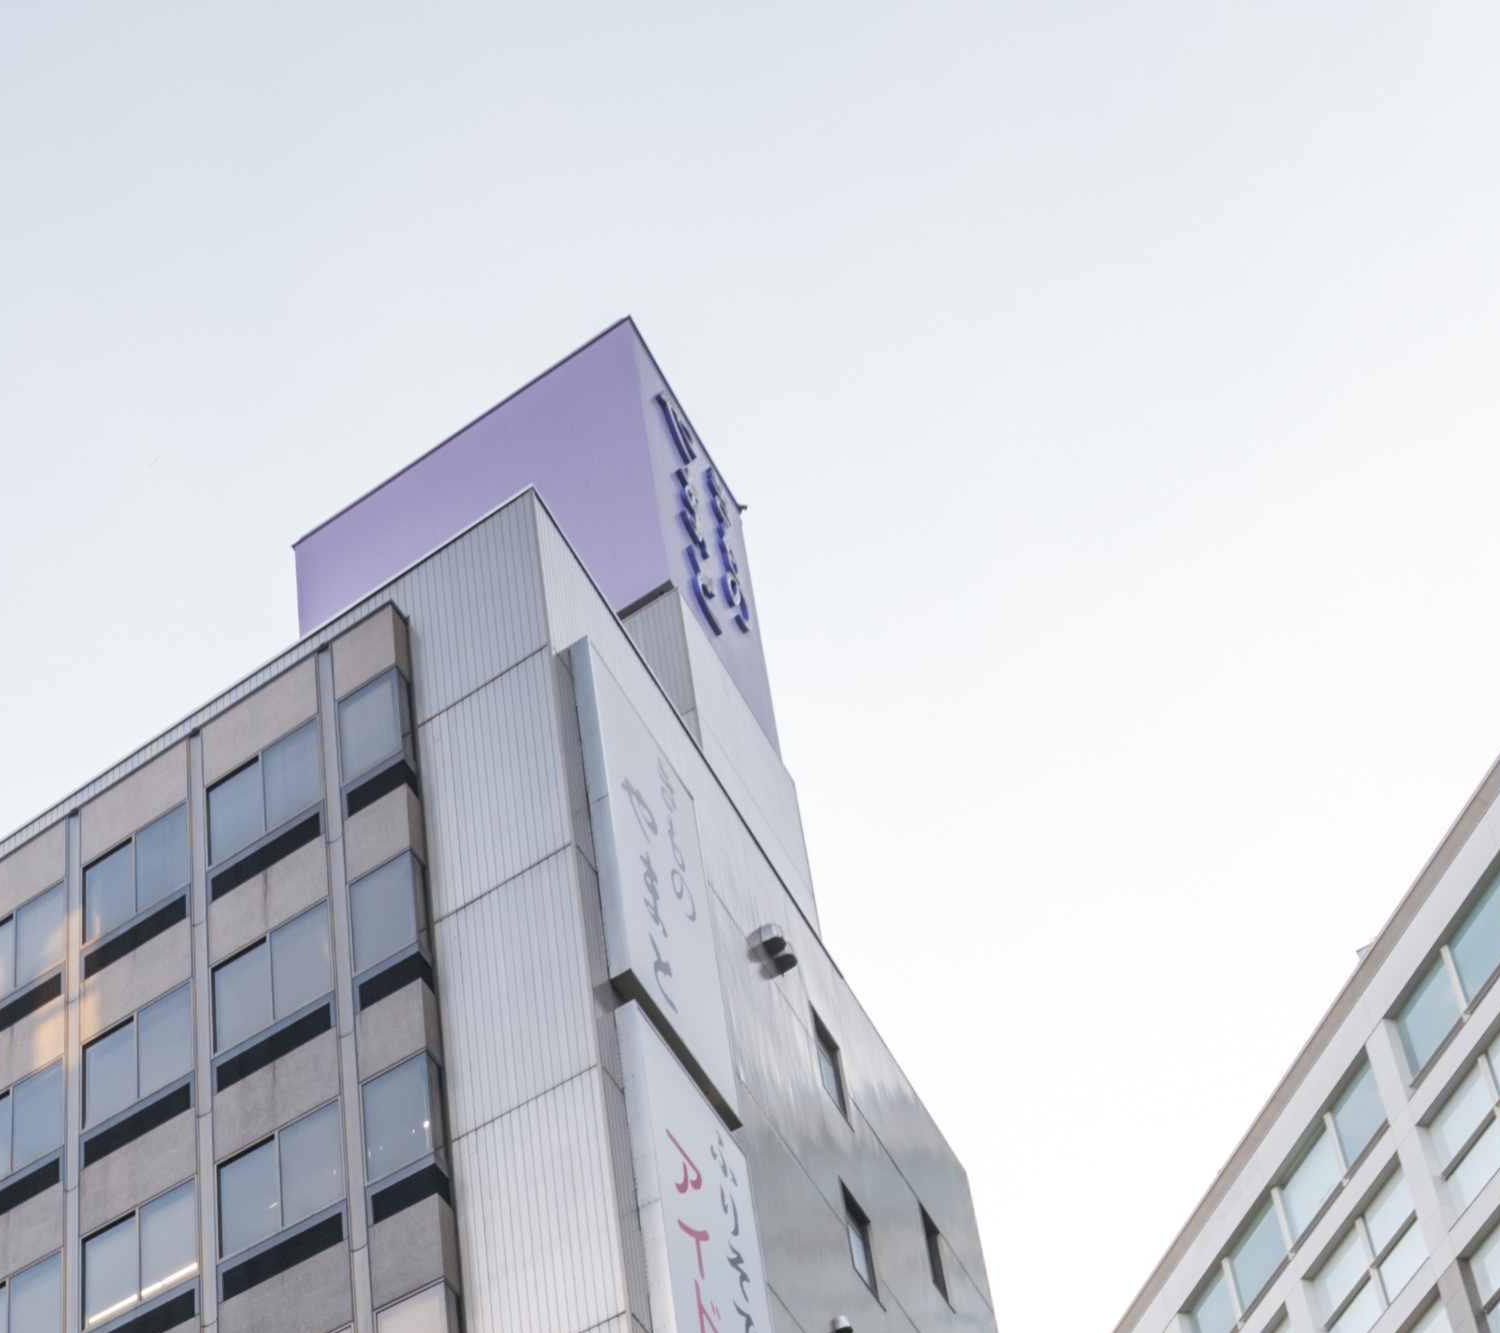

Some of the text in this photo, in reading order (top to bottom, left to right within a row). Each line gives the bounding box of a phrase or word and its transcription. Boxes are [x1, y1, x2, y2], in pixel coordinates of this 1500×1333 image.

[654, 391, 722, 636] やまと
[621, 776, 678, 1014] やまと
[658, 756, 696, 922] きもの
